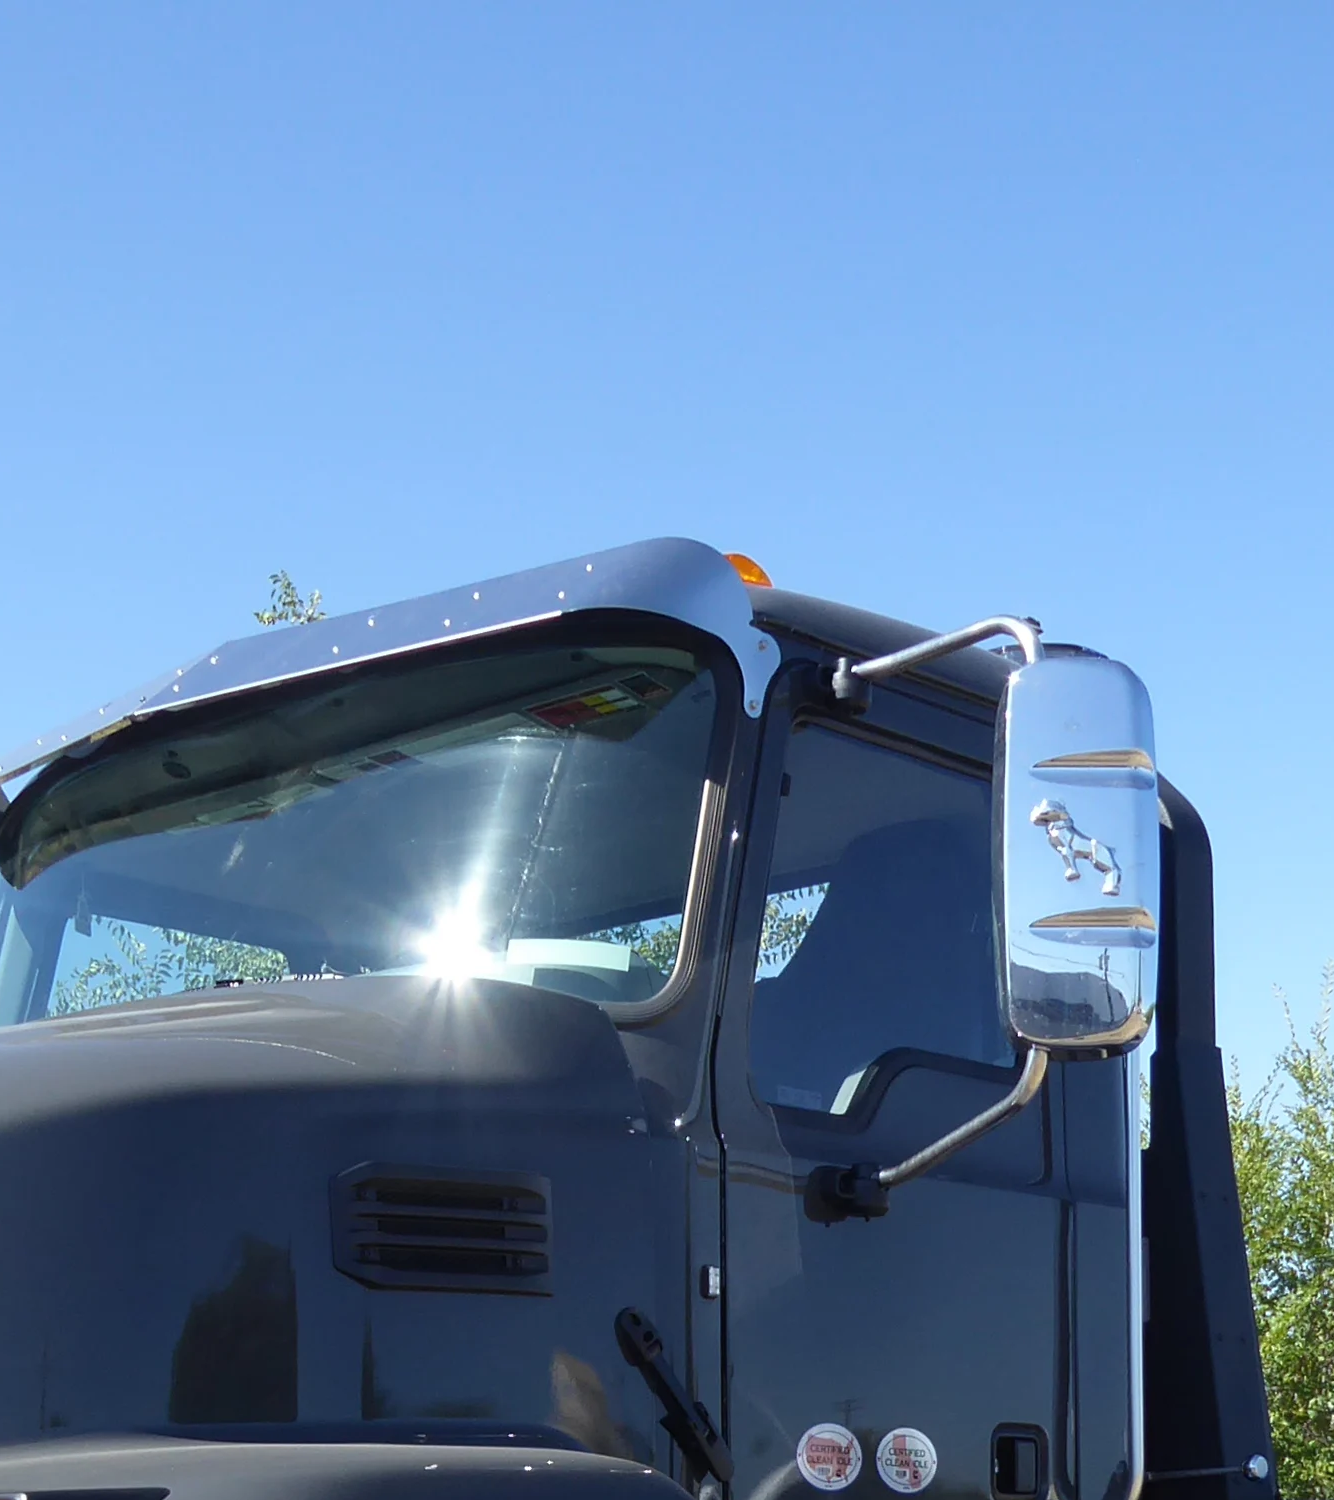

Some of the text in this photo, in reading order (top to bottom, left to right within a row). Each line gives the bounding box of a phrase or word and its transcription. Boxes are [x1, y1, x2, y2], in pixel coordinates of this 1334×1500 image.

[810, 1444, 850, 1455] CERTIFIED
[888, 1447, 926, 1458] CERTIFIED
[806, 1454, 833, 1465] CLEAN
[884, 1457, 910, 1467] CLEAN
